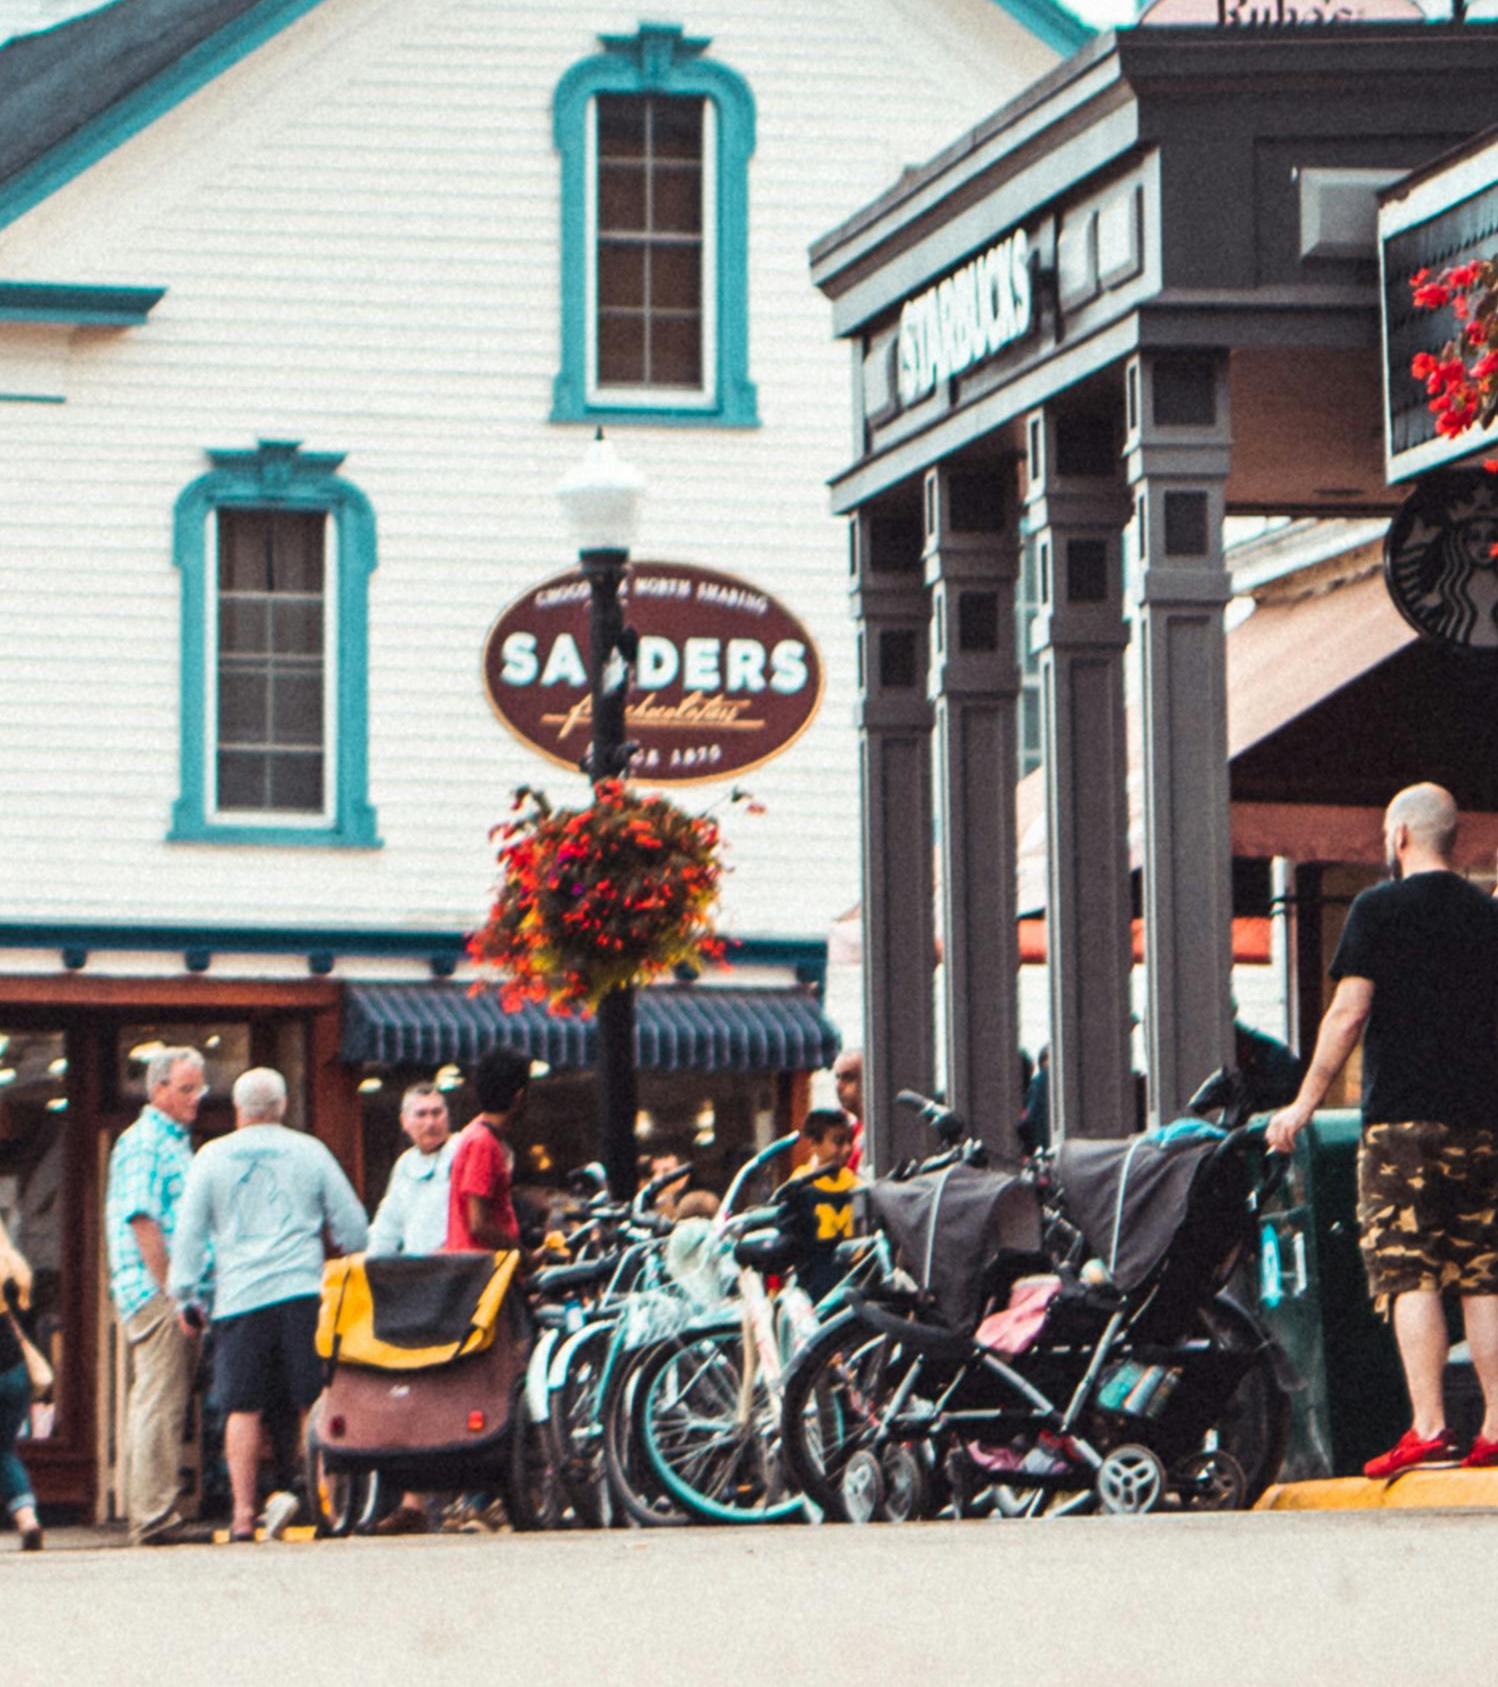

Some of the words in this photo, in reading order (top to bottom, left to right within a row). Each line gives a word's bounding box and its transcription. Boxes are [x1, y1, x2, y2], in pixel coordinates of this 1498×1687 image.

[898, 227, 1031, 406] STARBUCKS
[501, 632, 809, 694] SADERS
[815, 1202, 854, 1241] M
